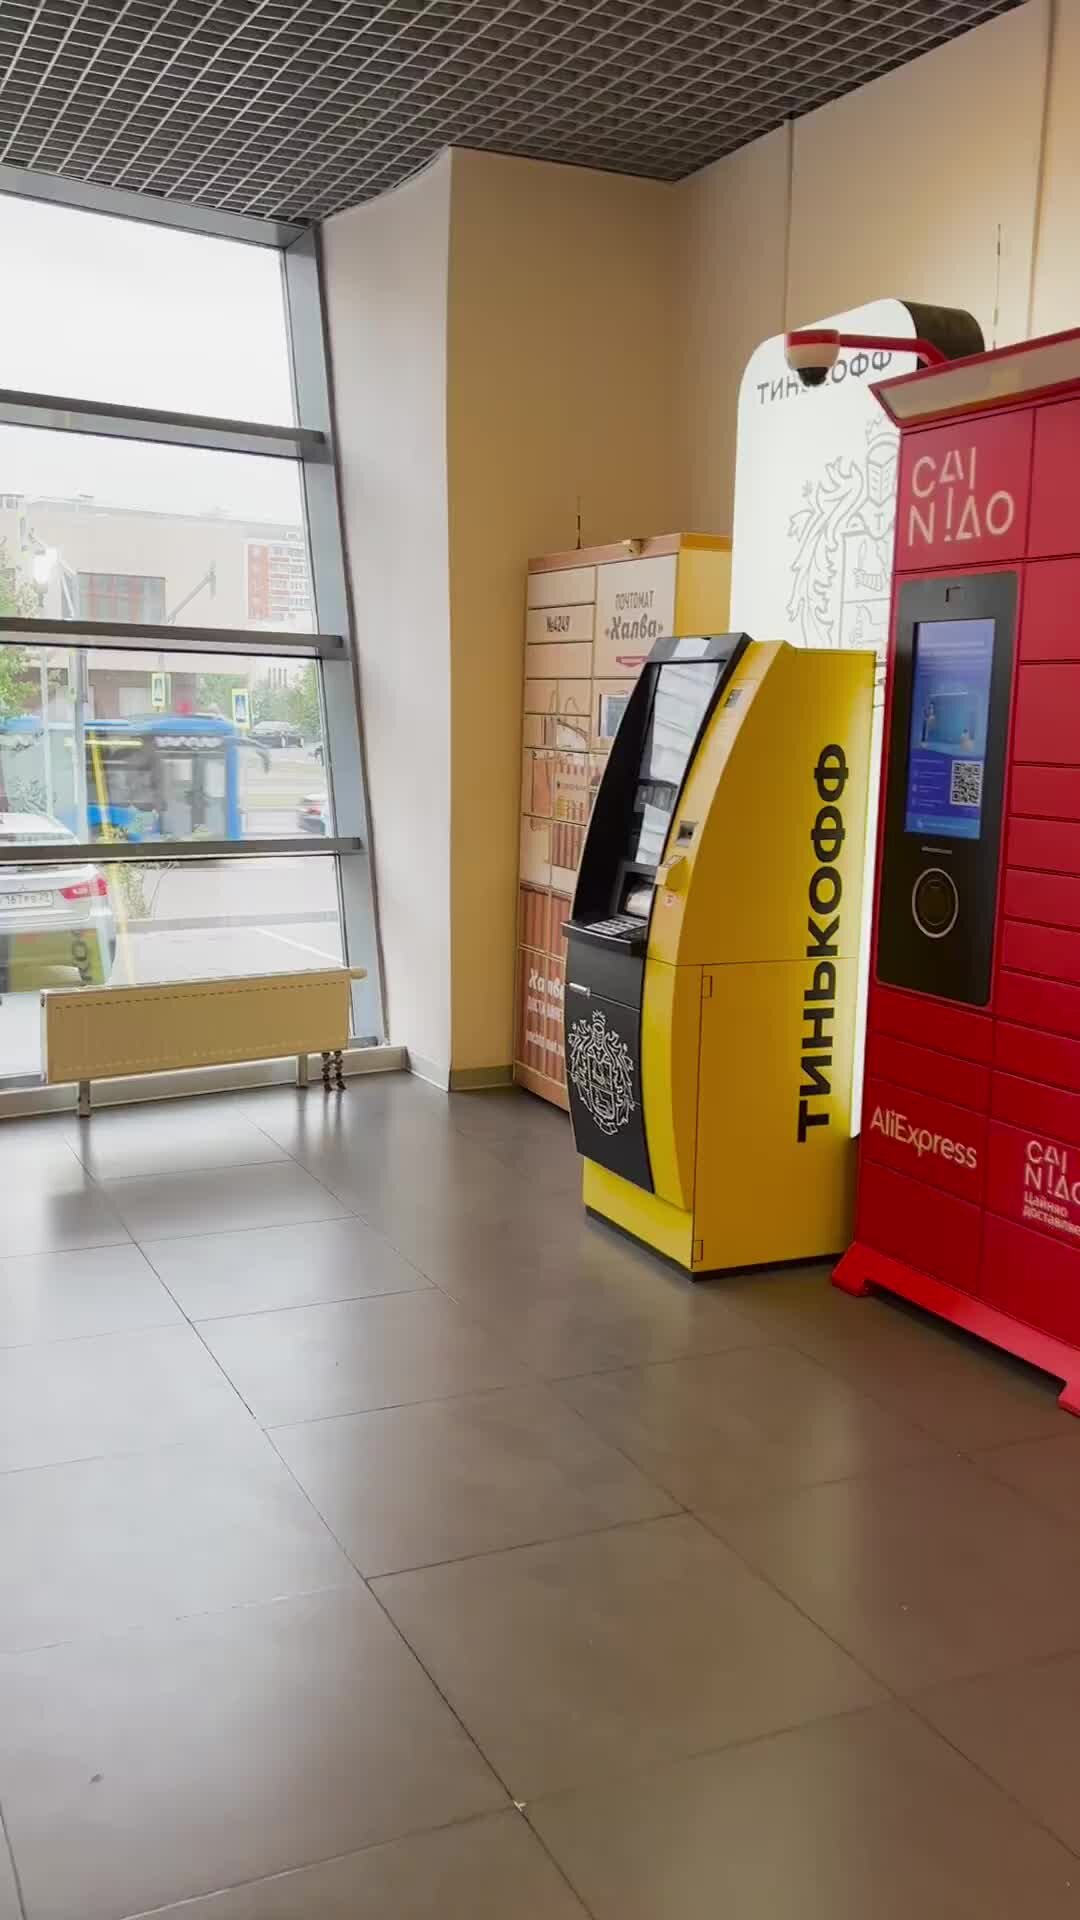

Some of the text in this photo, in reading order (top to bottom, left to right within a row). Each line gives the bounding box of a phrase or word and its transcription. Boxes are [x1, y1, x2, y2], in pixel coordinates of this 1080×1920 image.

[757, 351, 892, 404] ТИНОФФ
[911, 447, 977, 498] CAI
[615, 590, 655, 611] ПОЧТОМАТ
[797, 743, 849, 1143] ТИНЬКОФФ
[870, 1105, 977, 1169] AliExpress
